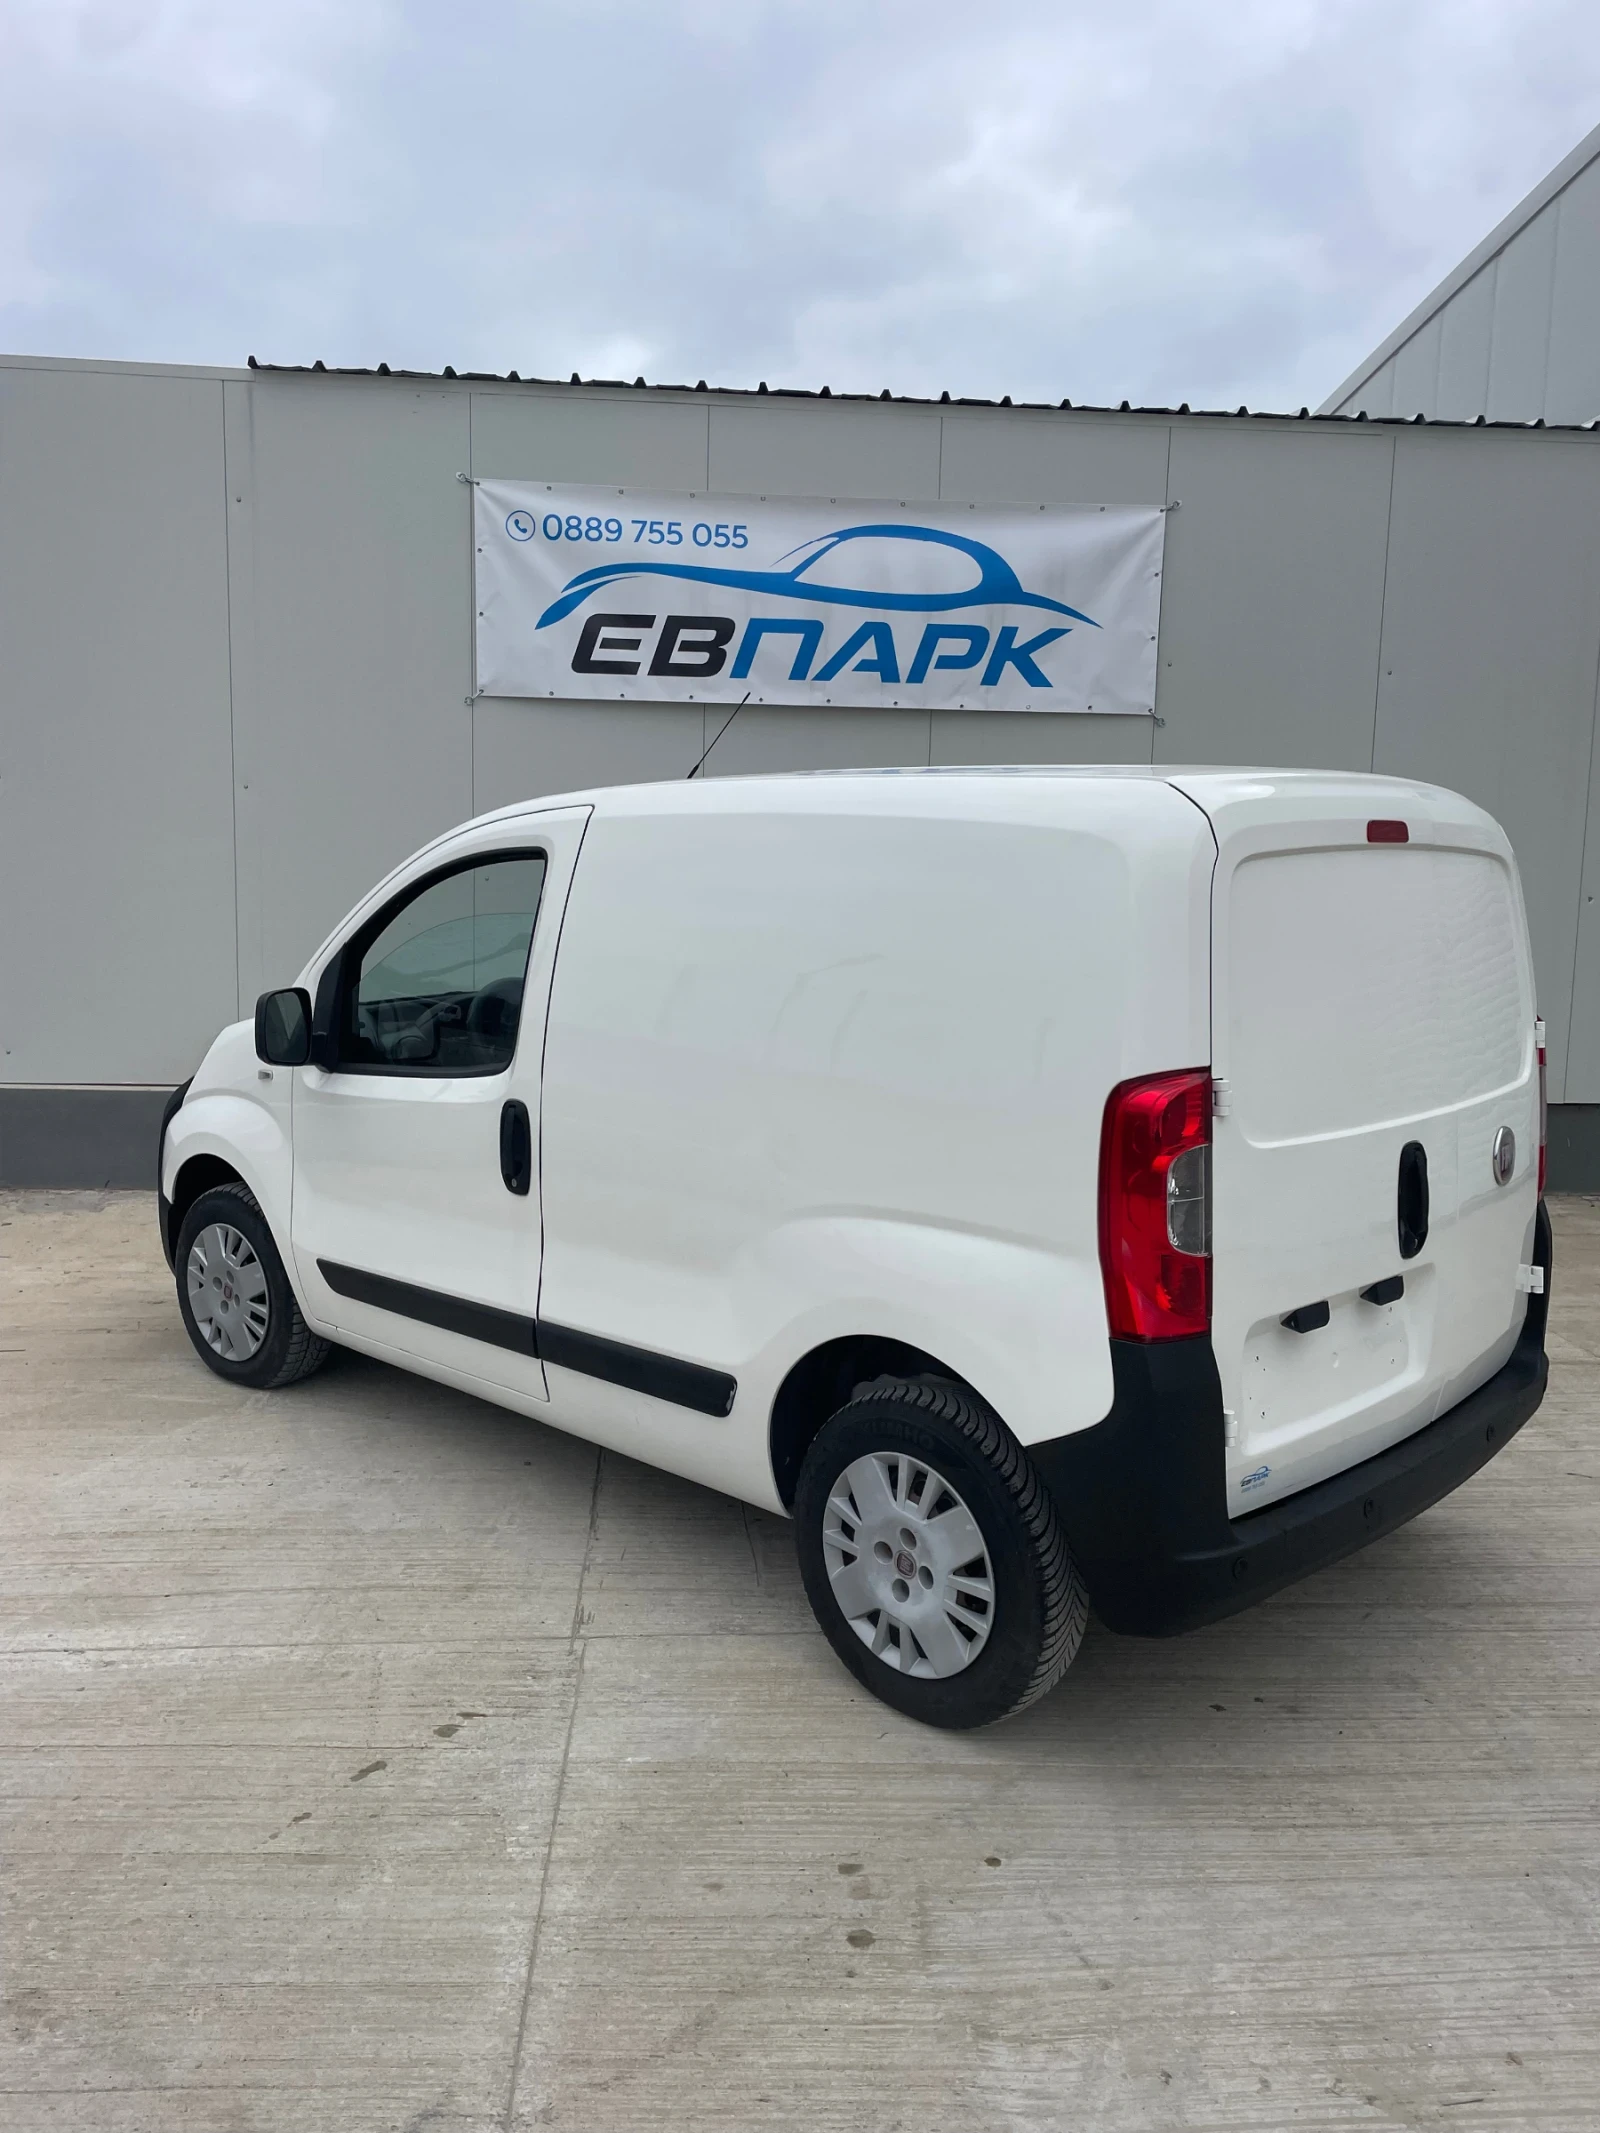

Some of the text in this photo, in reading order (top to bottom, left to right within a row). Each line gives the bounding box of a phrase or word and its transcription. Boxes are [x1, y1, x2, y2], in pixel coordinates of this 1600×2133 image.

[541, 513, 749, 549] 0889 755 055
[571, 613, 1073, 689] ЕВПАРК
